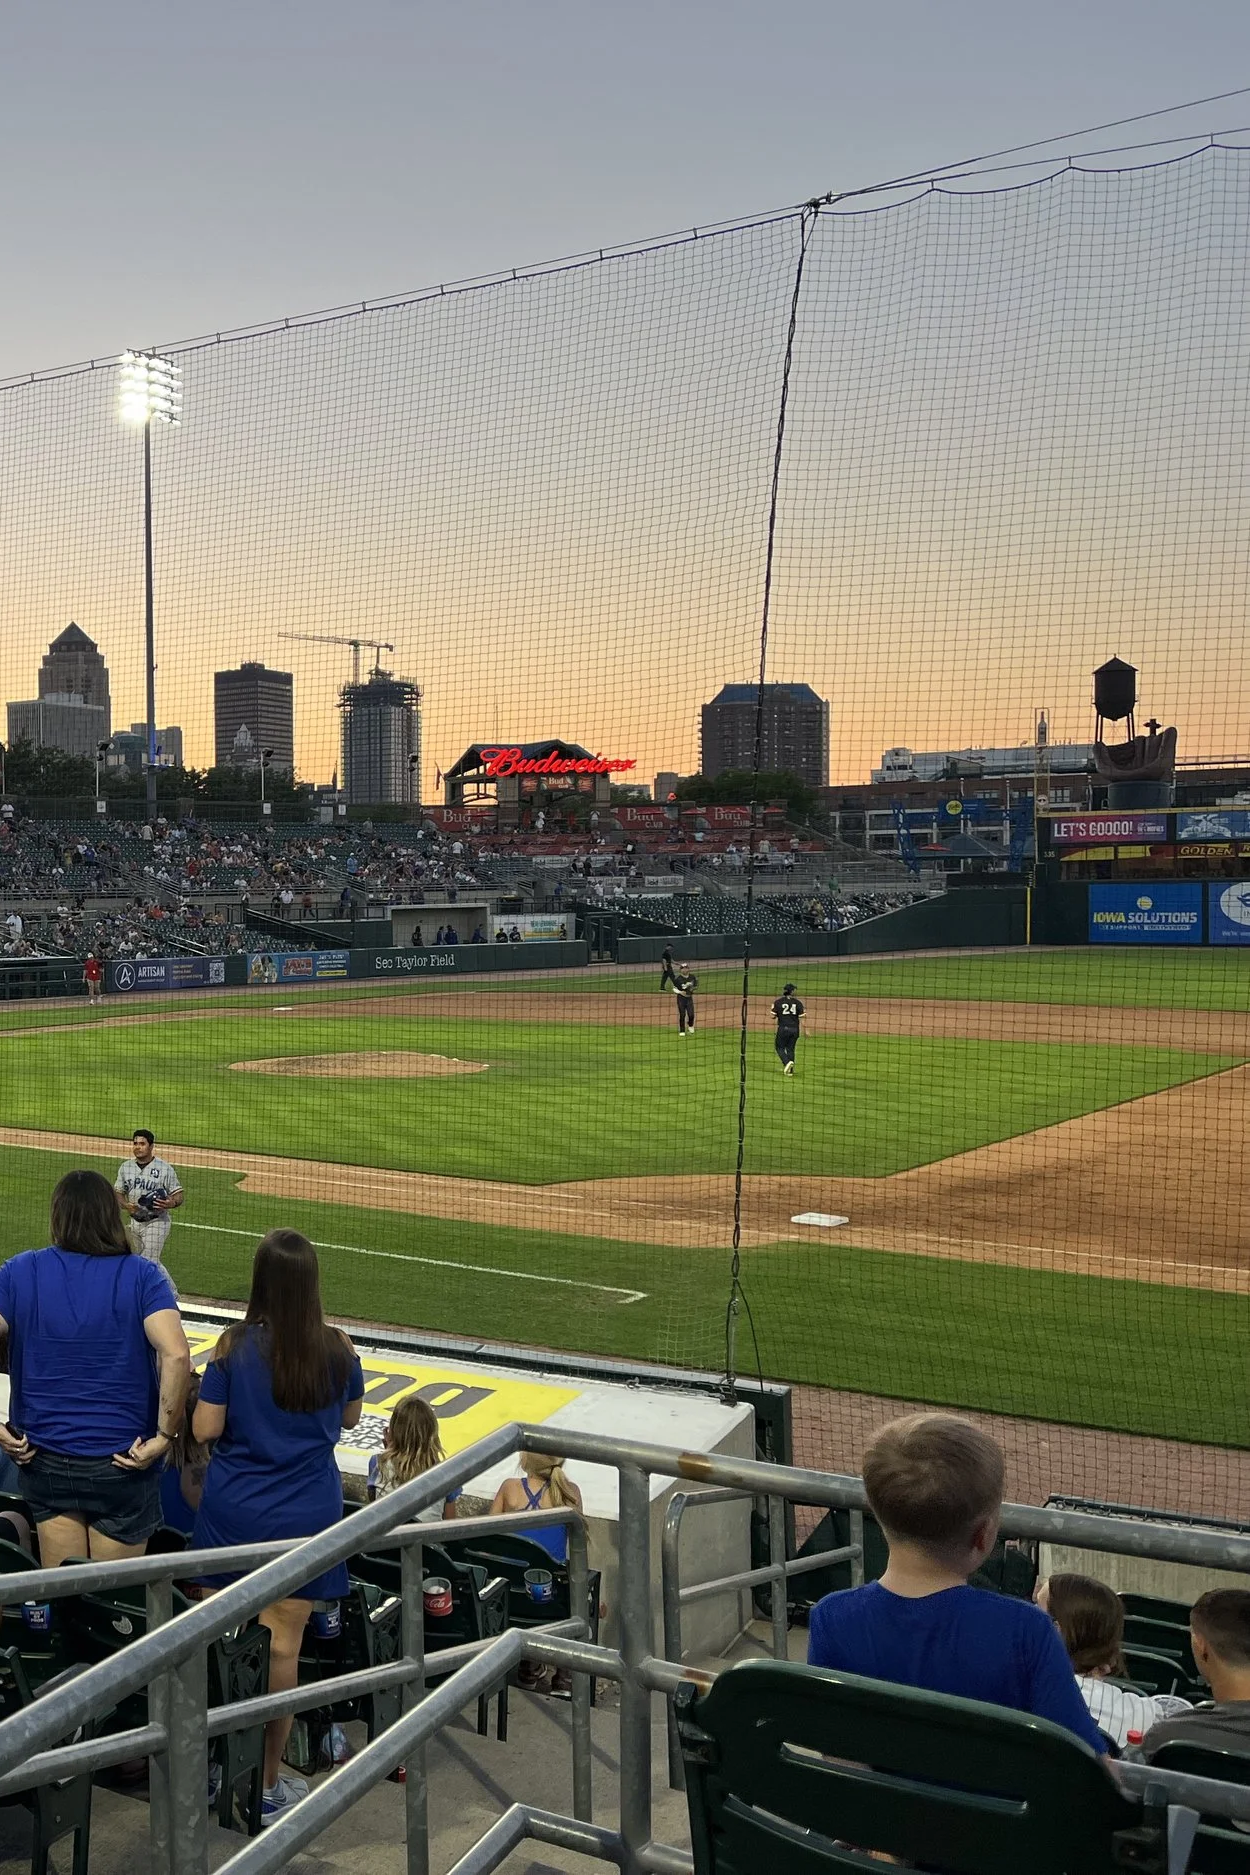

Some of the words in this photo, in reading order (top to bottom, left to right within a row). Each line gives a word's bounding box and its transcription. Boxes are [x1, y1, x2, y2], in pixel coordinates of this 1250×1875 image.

[480, 747, 638, 777] Budweiser
[442, 809, 471, 823] Bud
[1054, 822, 1087, 838] LET'S
[1088, 821, 1133, 836] GOOOO!
[1180, 846, 1232, 856] GOLDEN
[1093, 912, 1125, 923] IOWA
[1127, 912, 1197, 924] SOLUTIONS
[375, 956, 392, 969] Sec
[395, 955, 428, 970] Taylor
[430, 954, 455, 967] Field
[138, 966, 165, 978] ARTISAN
[782, 1003, 797, 1015] 24
